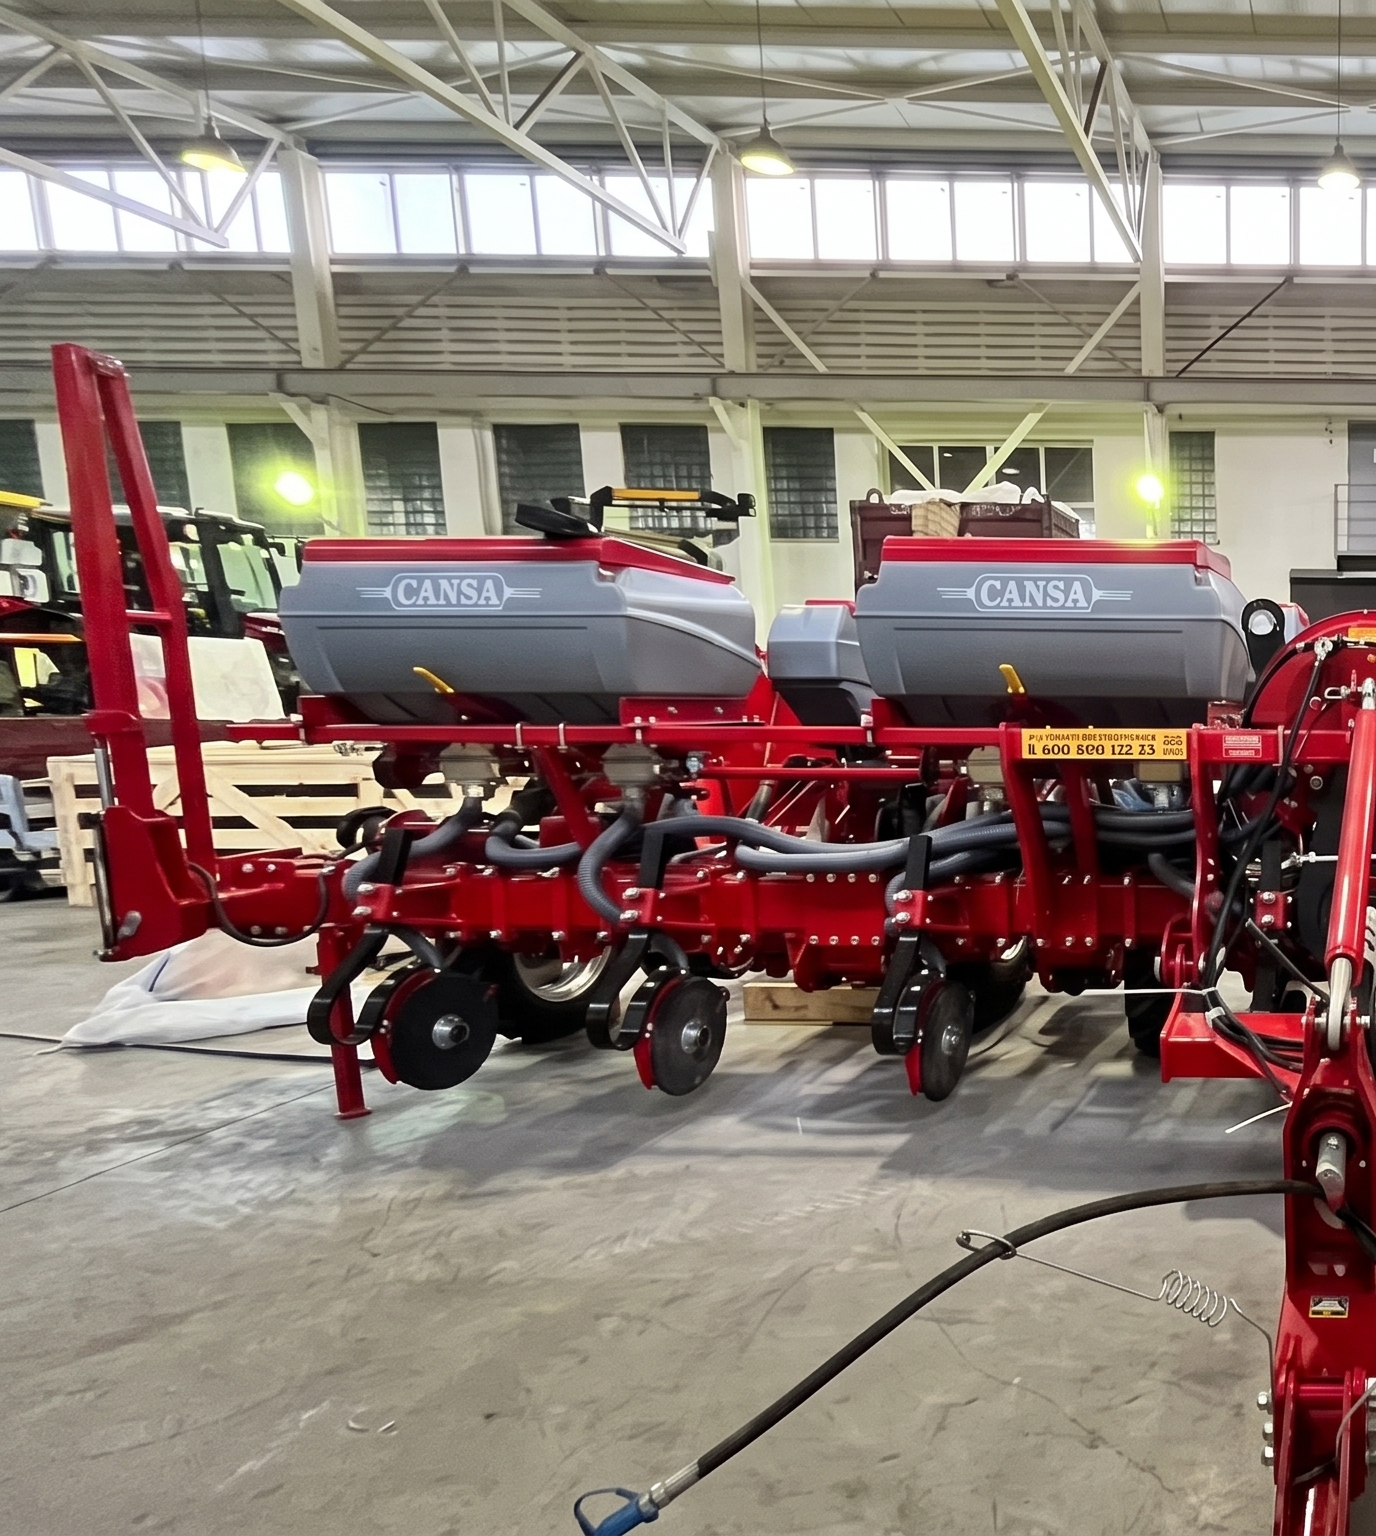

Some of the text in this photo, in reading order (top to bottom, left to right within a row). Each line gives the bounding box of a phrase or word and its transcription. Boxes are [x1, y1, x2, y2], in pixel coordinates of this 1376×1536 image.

[397, 579, 500, 605] CANSA
[980, 580, 1088, 607] CANSA
[1042, 744, 1070, 756] 600
